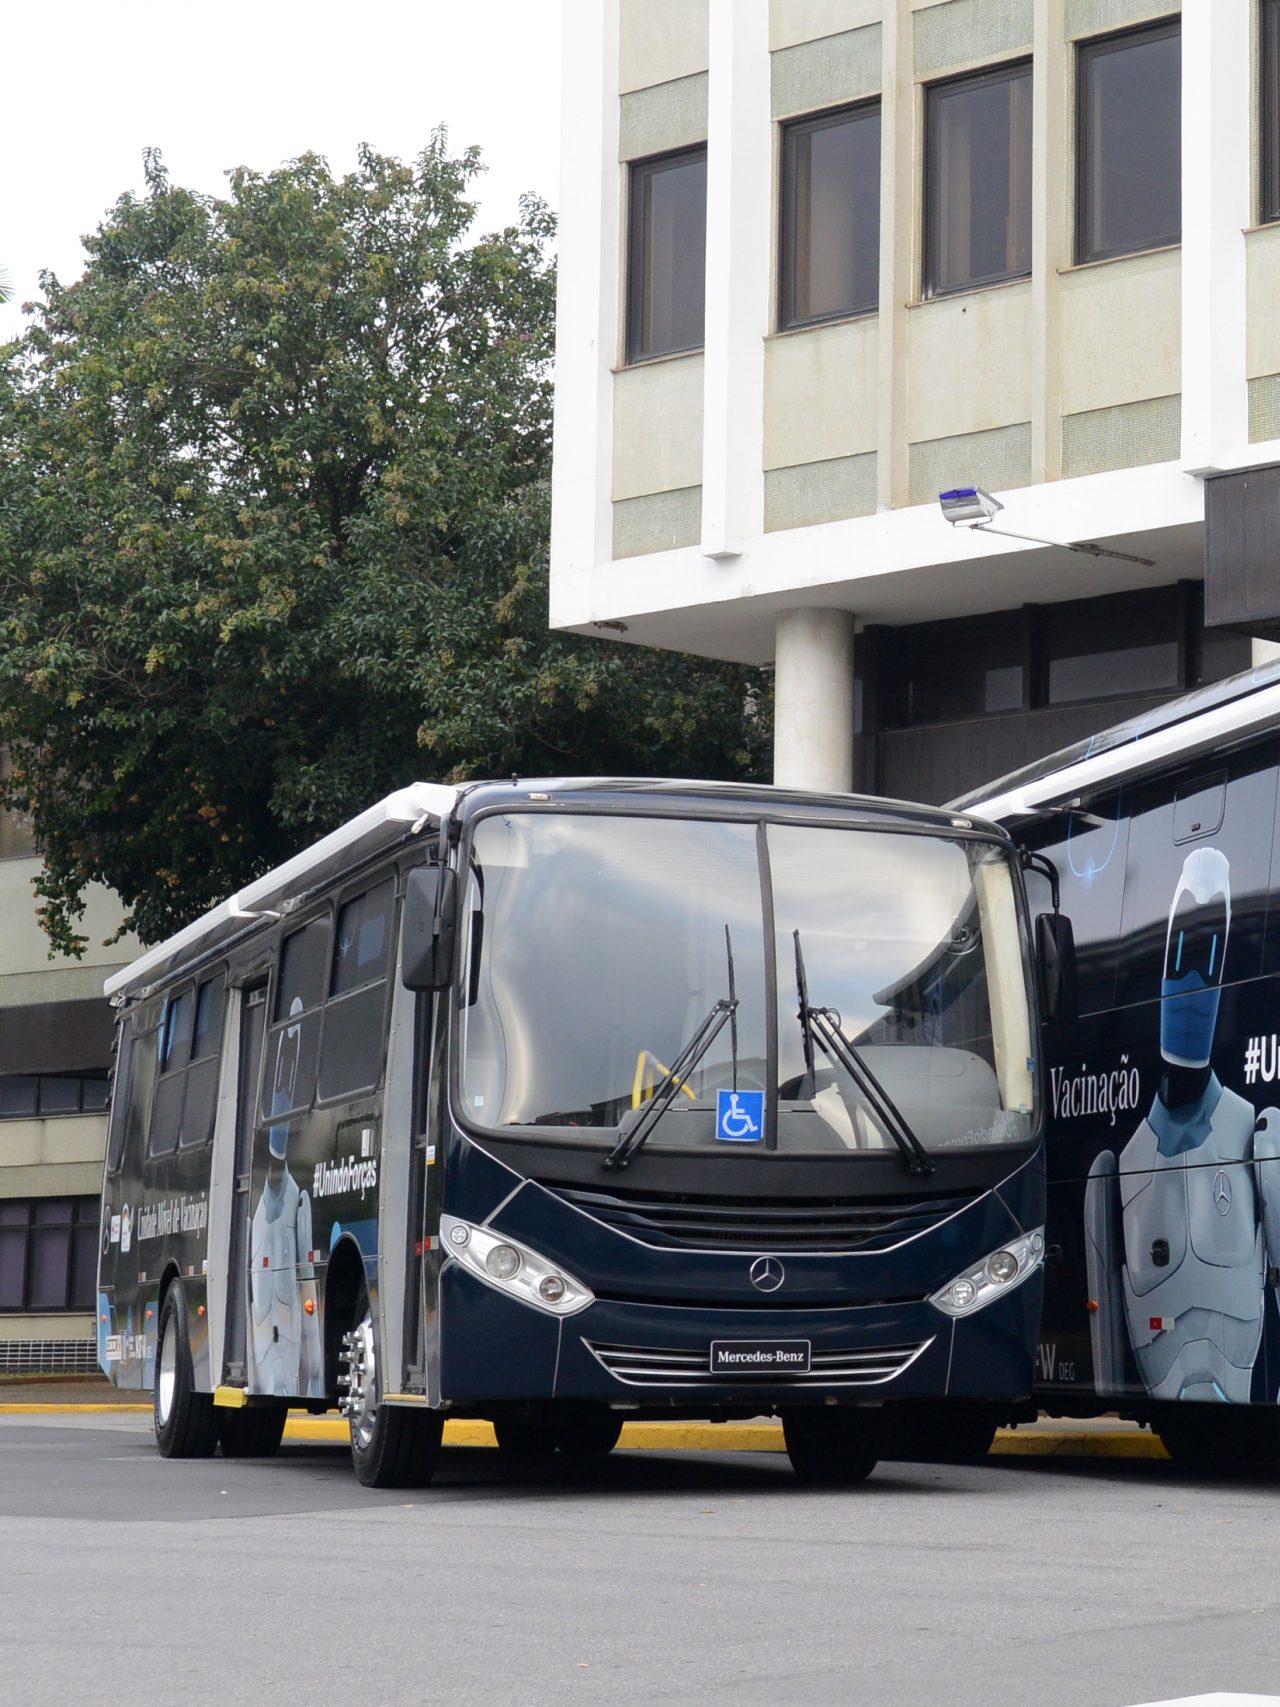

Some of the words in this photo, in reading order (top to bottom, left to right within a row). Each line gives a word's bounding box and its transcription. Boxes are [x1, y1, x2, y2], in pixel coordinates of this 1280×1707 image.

[1050, 1053, 1140, 1127] Vacinação
[312, 1154, 377, 1201] #UnindoForças
[717, 1350, 804, 1363] Mercedes-Benz
[1058, 1362, 1075, 1381] DEG
